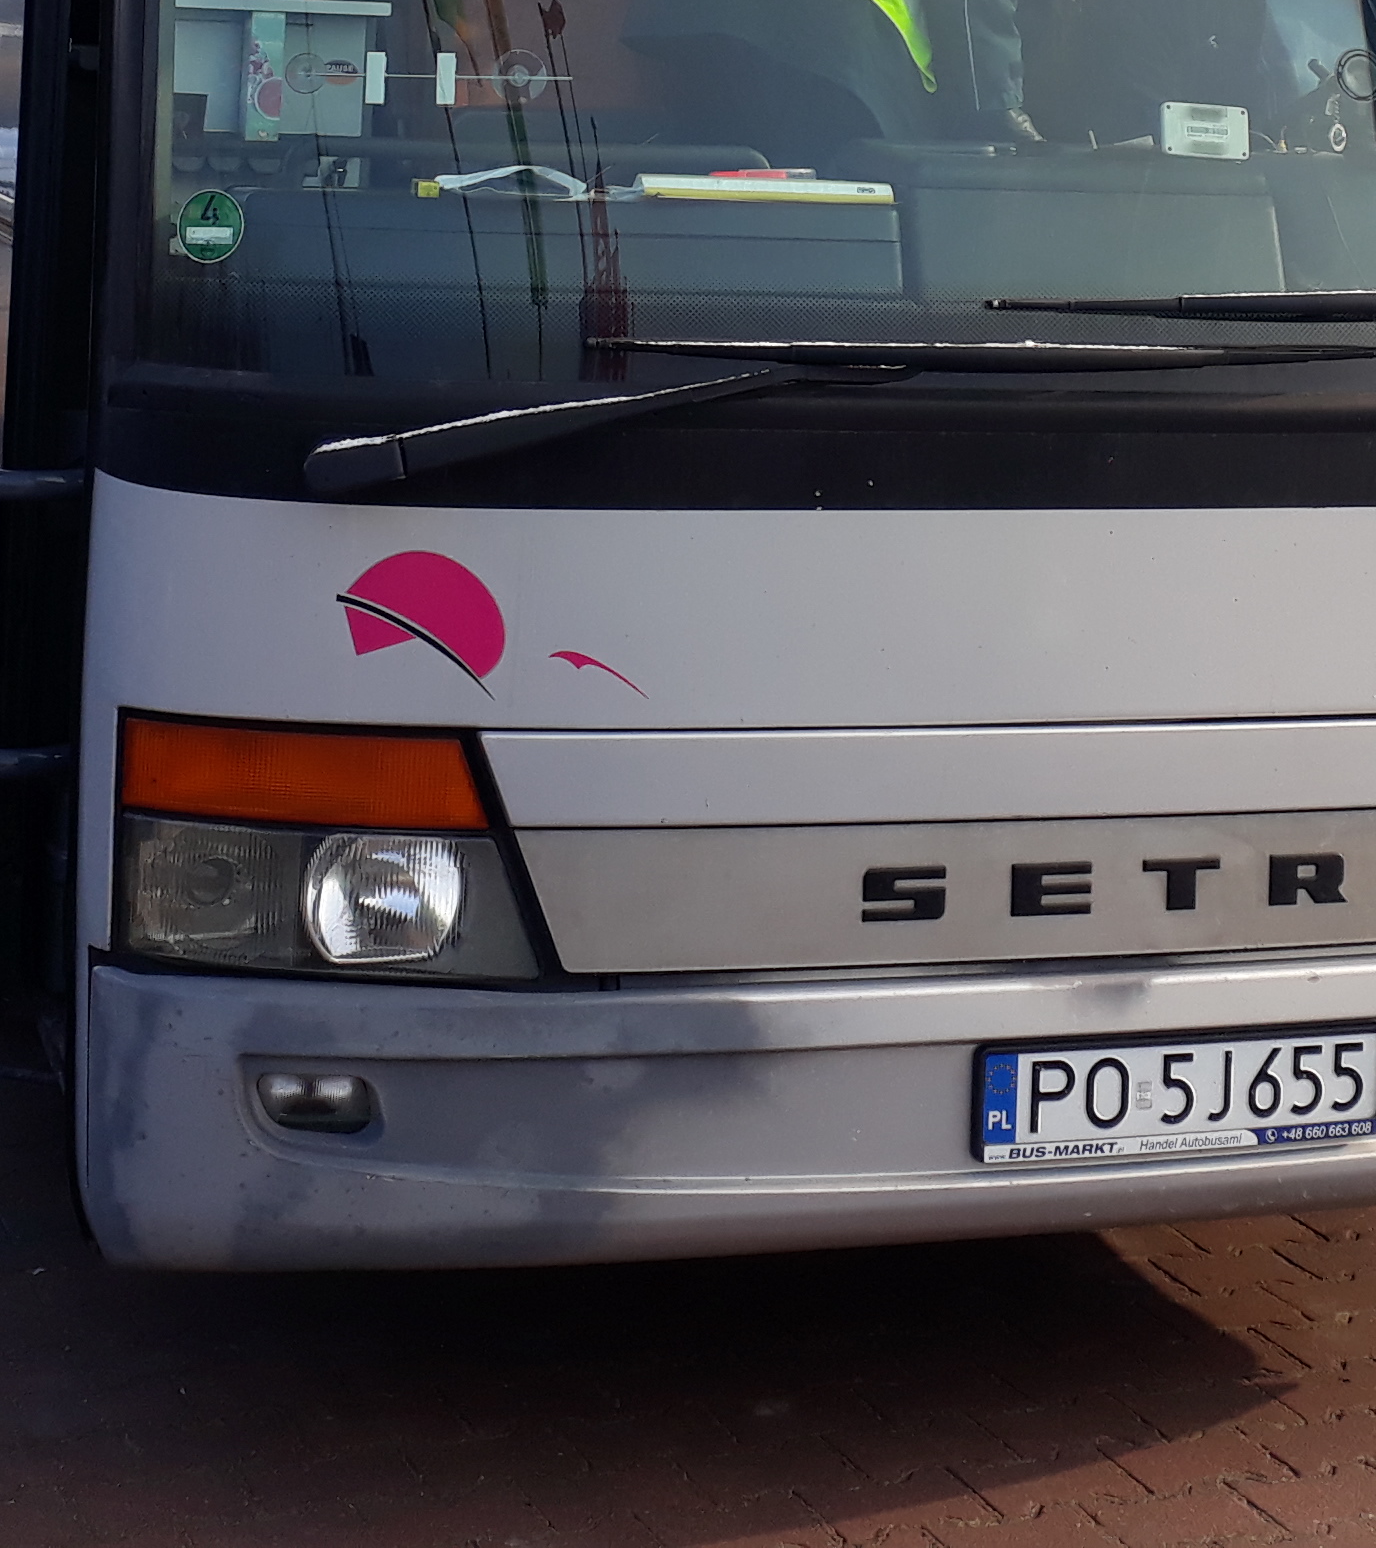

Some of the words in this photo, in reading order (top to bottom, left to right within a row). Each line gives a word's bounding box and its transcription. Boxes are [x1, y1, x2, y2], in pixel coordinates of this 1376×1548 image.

[200, 194, 220, 226] 4
[1030, 1056, 1131, 1134] PO
[1160, 1041, 1364, 1125] 5J655
[987, 1110, 1012, 1131] PL
[1140, 1137, 1178, 1151] Handel
[1179, 1133, 1243, 1150] Autobusami
[1282, 1127, 1303, 1140] +48
[1305, 1126, 1326, 1139] 660
[1329, 1124, 1349, 1137] 663
[1352, 1122, 1372, 1135] 608
